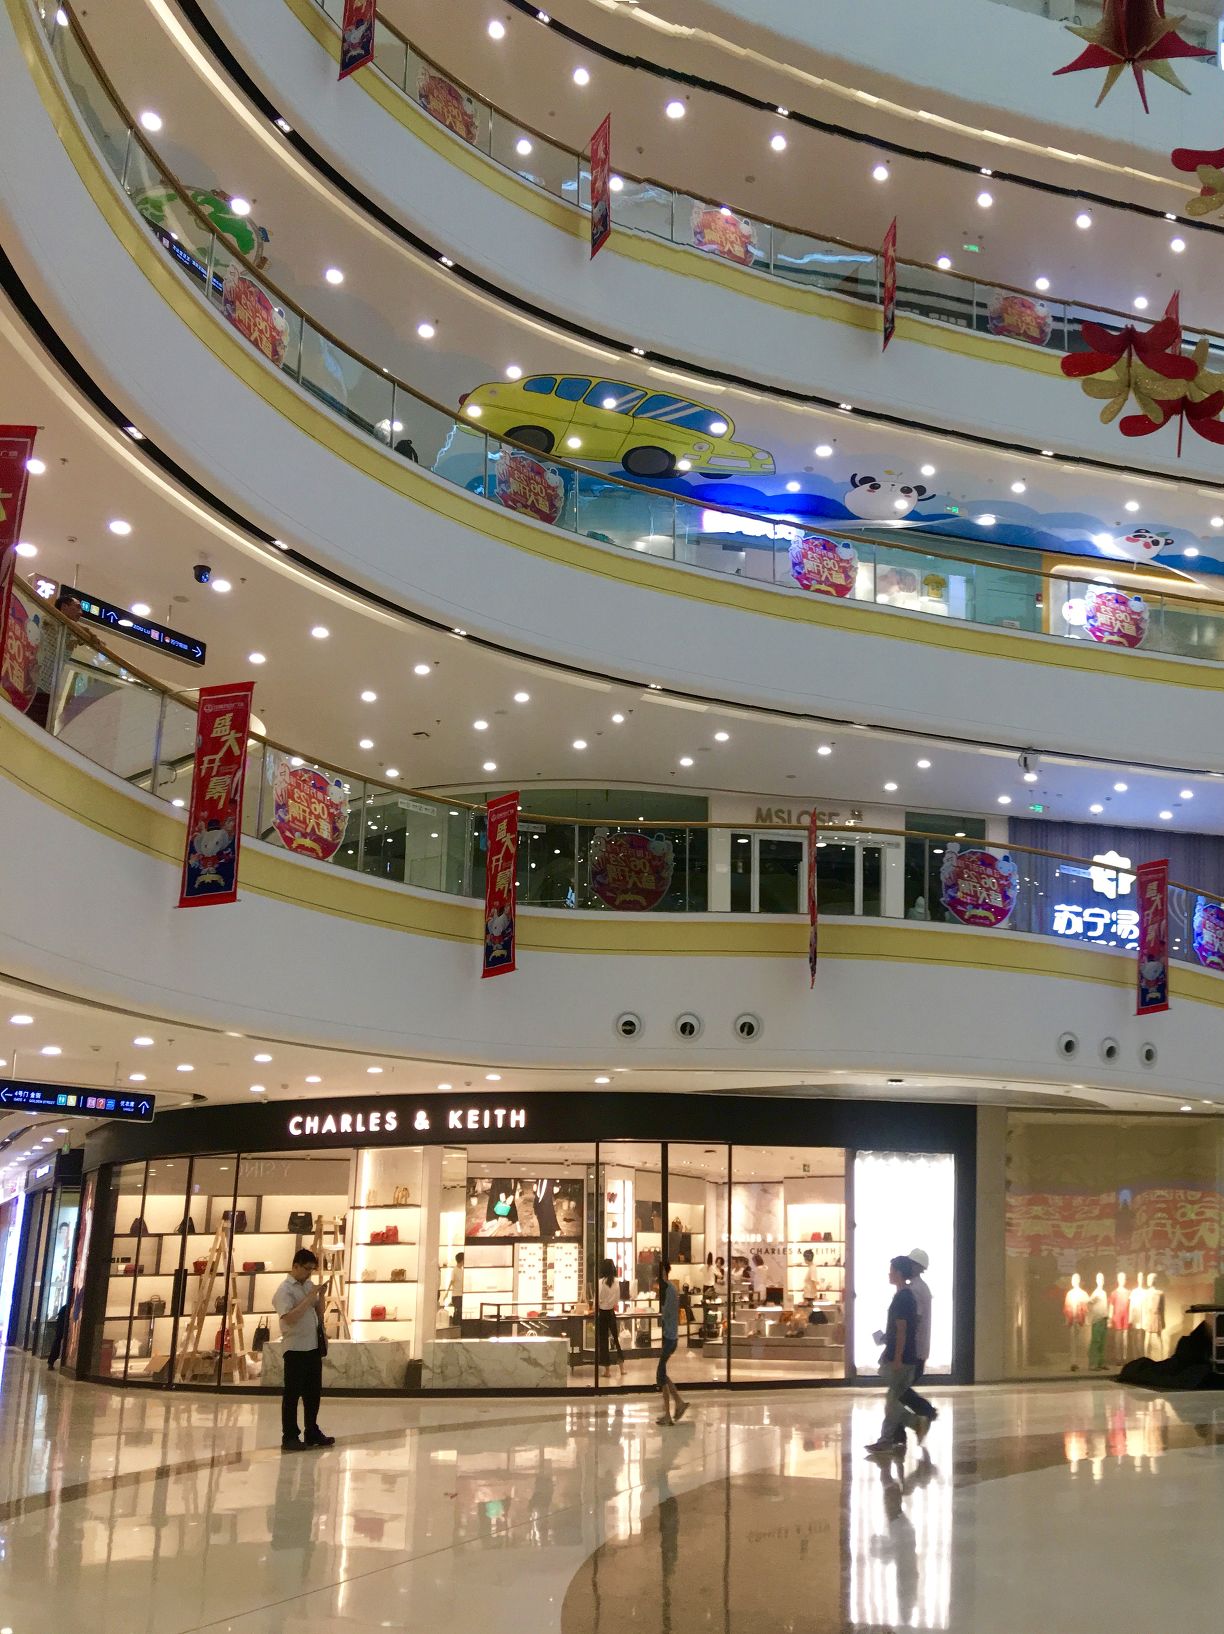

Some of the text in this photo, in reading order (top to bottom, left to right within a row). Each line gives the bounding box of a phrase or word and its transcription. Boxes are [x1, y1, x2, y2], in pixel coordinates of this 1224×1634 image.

[35, 580, 55, 598] 2F
[288, 1109, 527, 1136] CHARLES & KEITH
[750, 1247, 793, 1255] CHARLES
